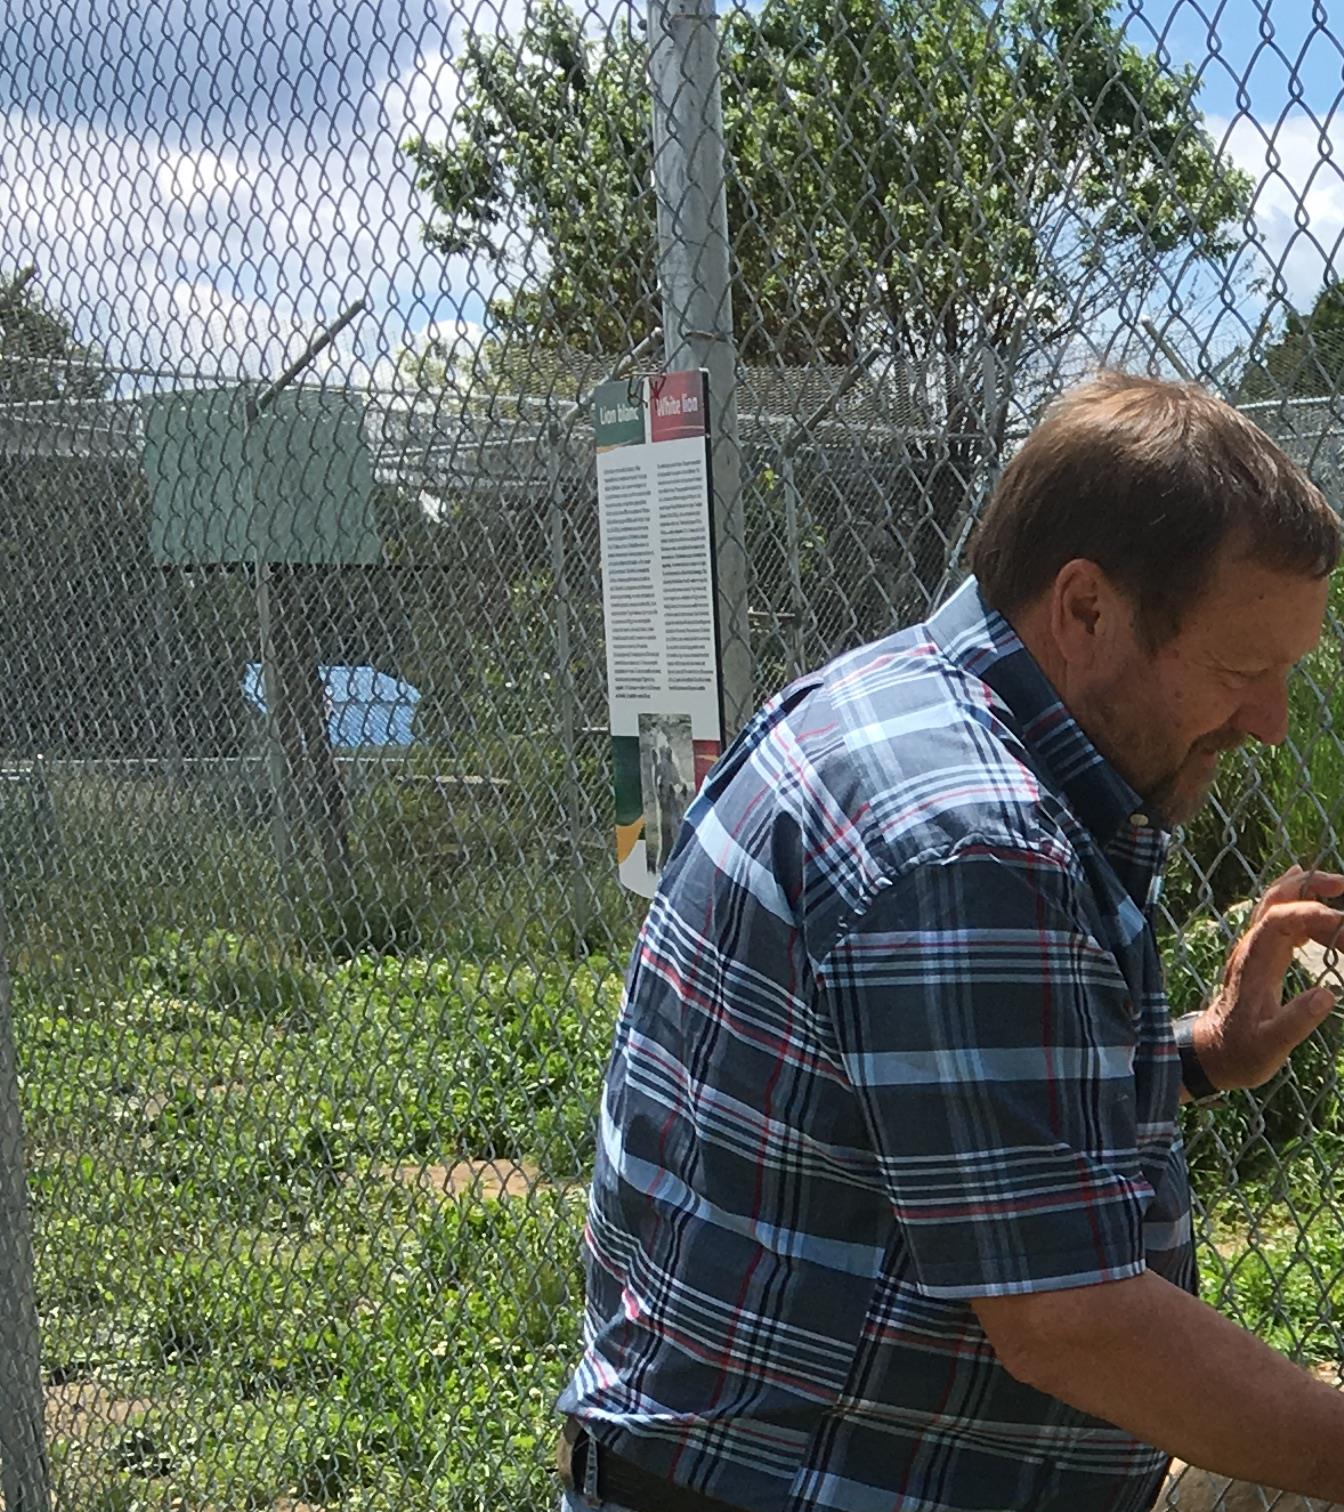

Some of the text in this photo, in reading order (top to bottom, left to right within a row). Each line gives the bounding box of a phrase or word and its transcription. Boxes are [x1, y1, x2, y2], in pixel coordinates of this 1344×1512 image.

[600, 405, 617, 425] Lion
[656, 393, 699, 417] White lion
